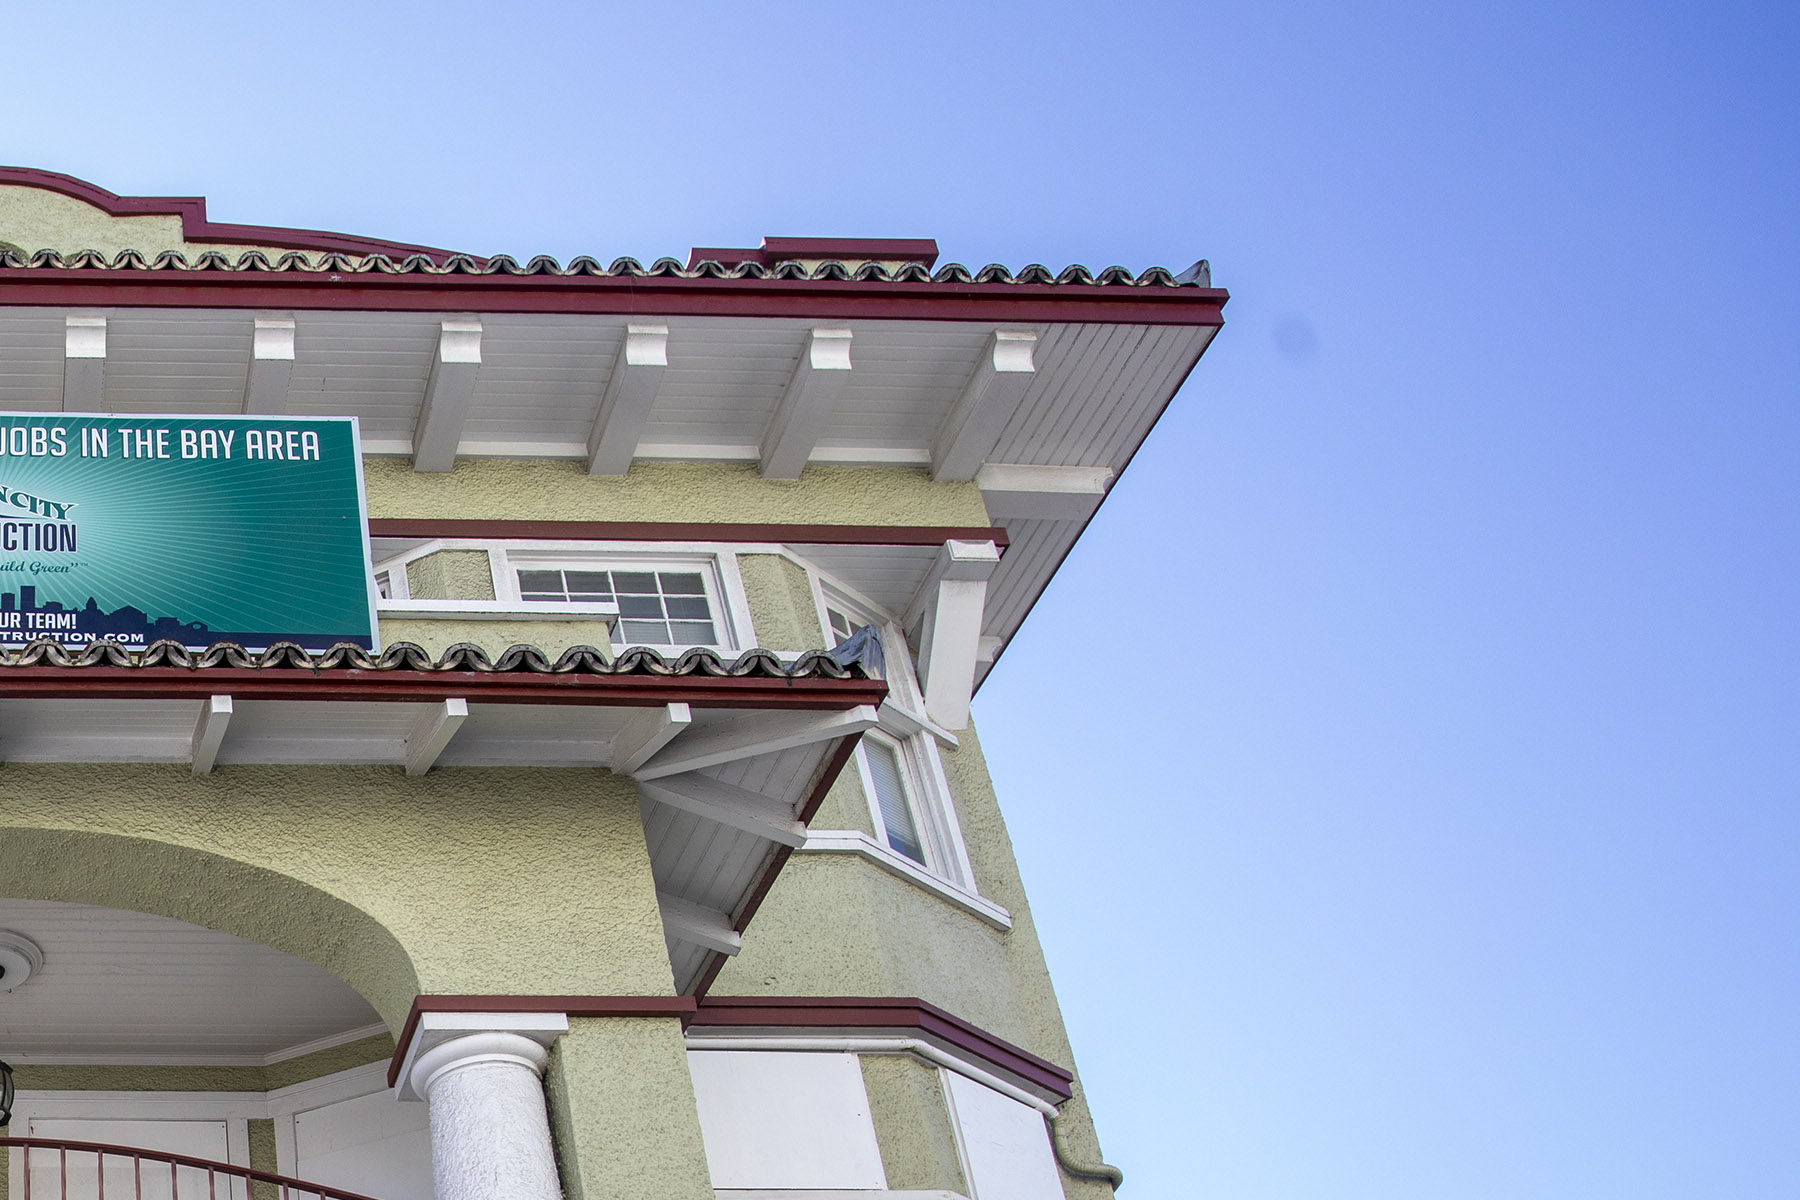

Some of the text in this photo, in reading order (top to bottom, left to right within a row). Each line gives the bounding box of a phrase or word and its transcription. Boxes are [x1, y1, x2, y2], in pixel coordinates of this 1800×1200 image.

[80, 427, 109, 458] IN
[117, 428, 171, 459] THE
[180, 429, 236, 460] BAY
[245, 429, 321, 461] AREA
[9, 490, 76, 521] CITY
[26, 611, 78, 630] TEAM!
